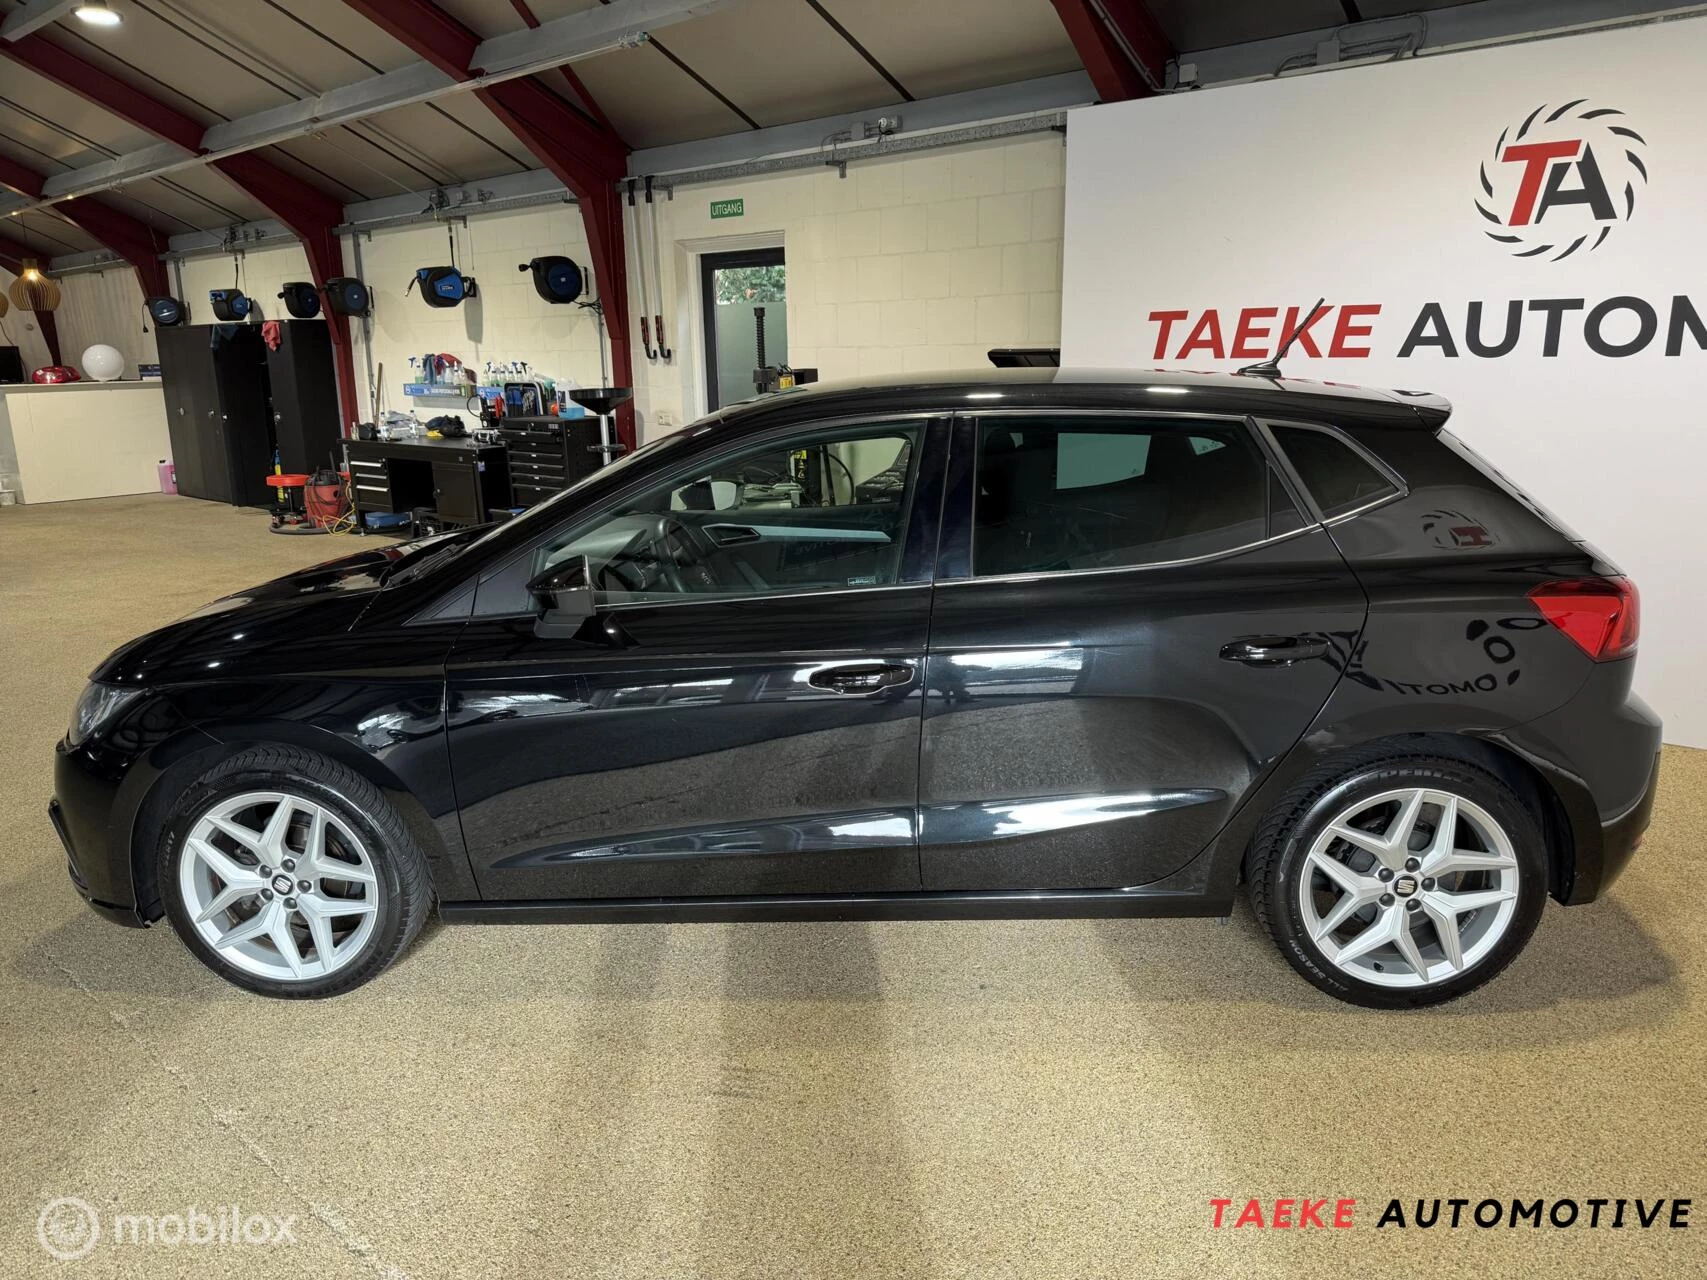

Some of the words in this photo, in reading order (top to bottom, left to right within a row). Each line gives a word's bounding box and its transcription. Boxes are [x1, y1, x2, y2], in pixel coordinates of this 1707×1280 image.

[711, 202, 742, 216] UITGANG
[1502, 139, 1617, 226] TA
[1148, 303, 1382, 360] TAEKE
